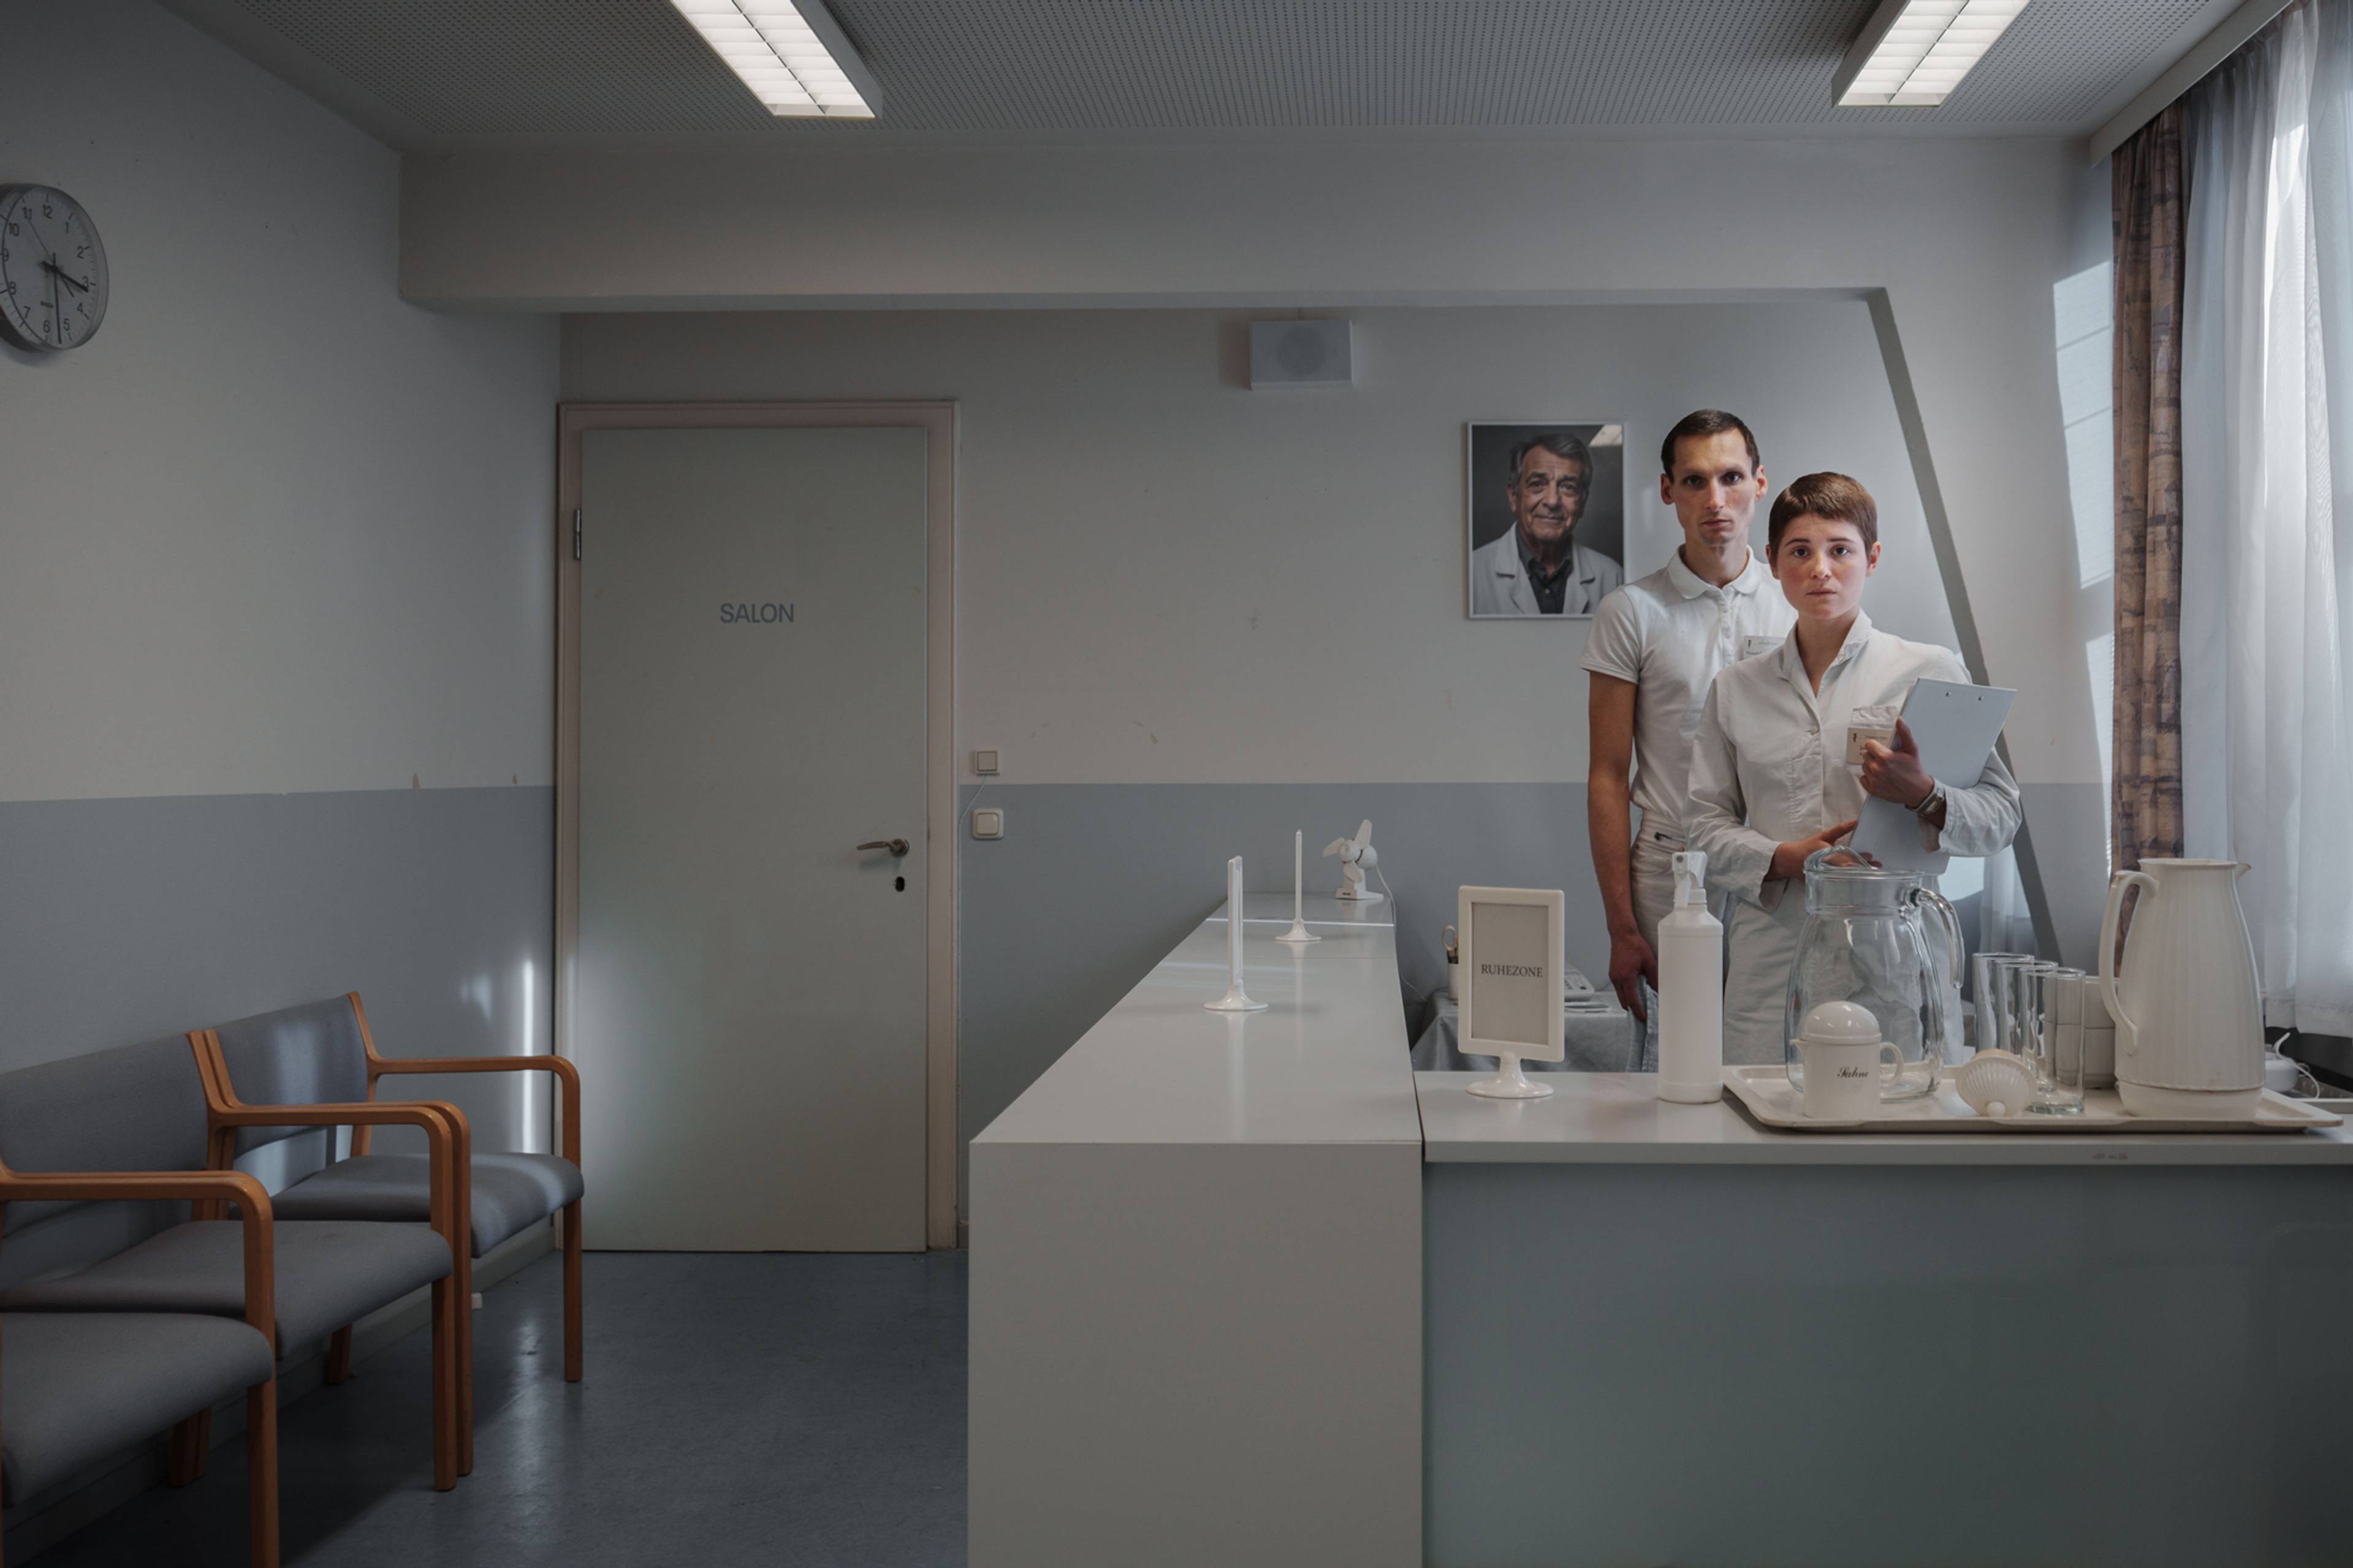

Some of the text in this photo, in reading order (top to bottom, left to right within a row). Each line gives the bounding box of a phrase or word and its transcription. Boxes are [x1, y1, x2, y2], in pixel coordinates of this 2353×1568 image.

[23, 206, 32, 219] 11
[43, 204, 53, 219] 12
[9, 222, 20, 237] 10
[64, 222, 69, 234] 1
[3, 248, 9, 262] 9
[77, 246, 83, 259] 2
[9, 281, 16, 295] 8
[82, 276, 89, 289] 3
[24, 306, 30, 319] 7
[77, 302, 83, 314] 4
[43, 319, 50, 333] 6
[63, 318, 70, 331] 5
[720, 603, 794, 623] SALON
[1481, 964, 1544, 978] RUHEZONE
[1837, 1066, 1868, 1078] Sahne
